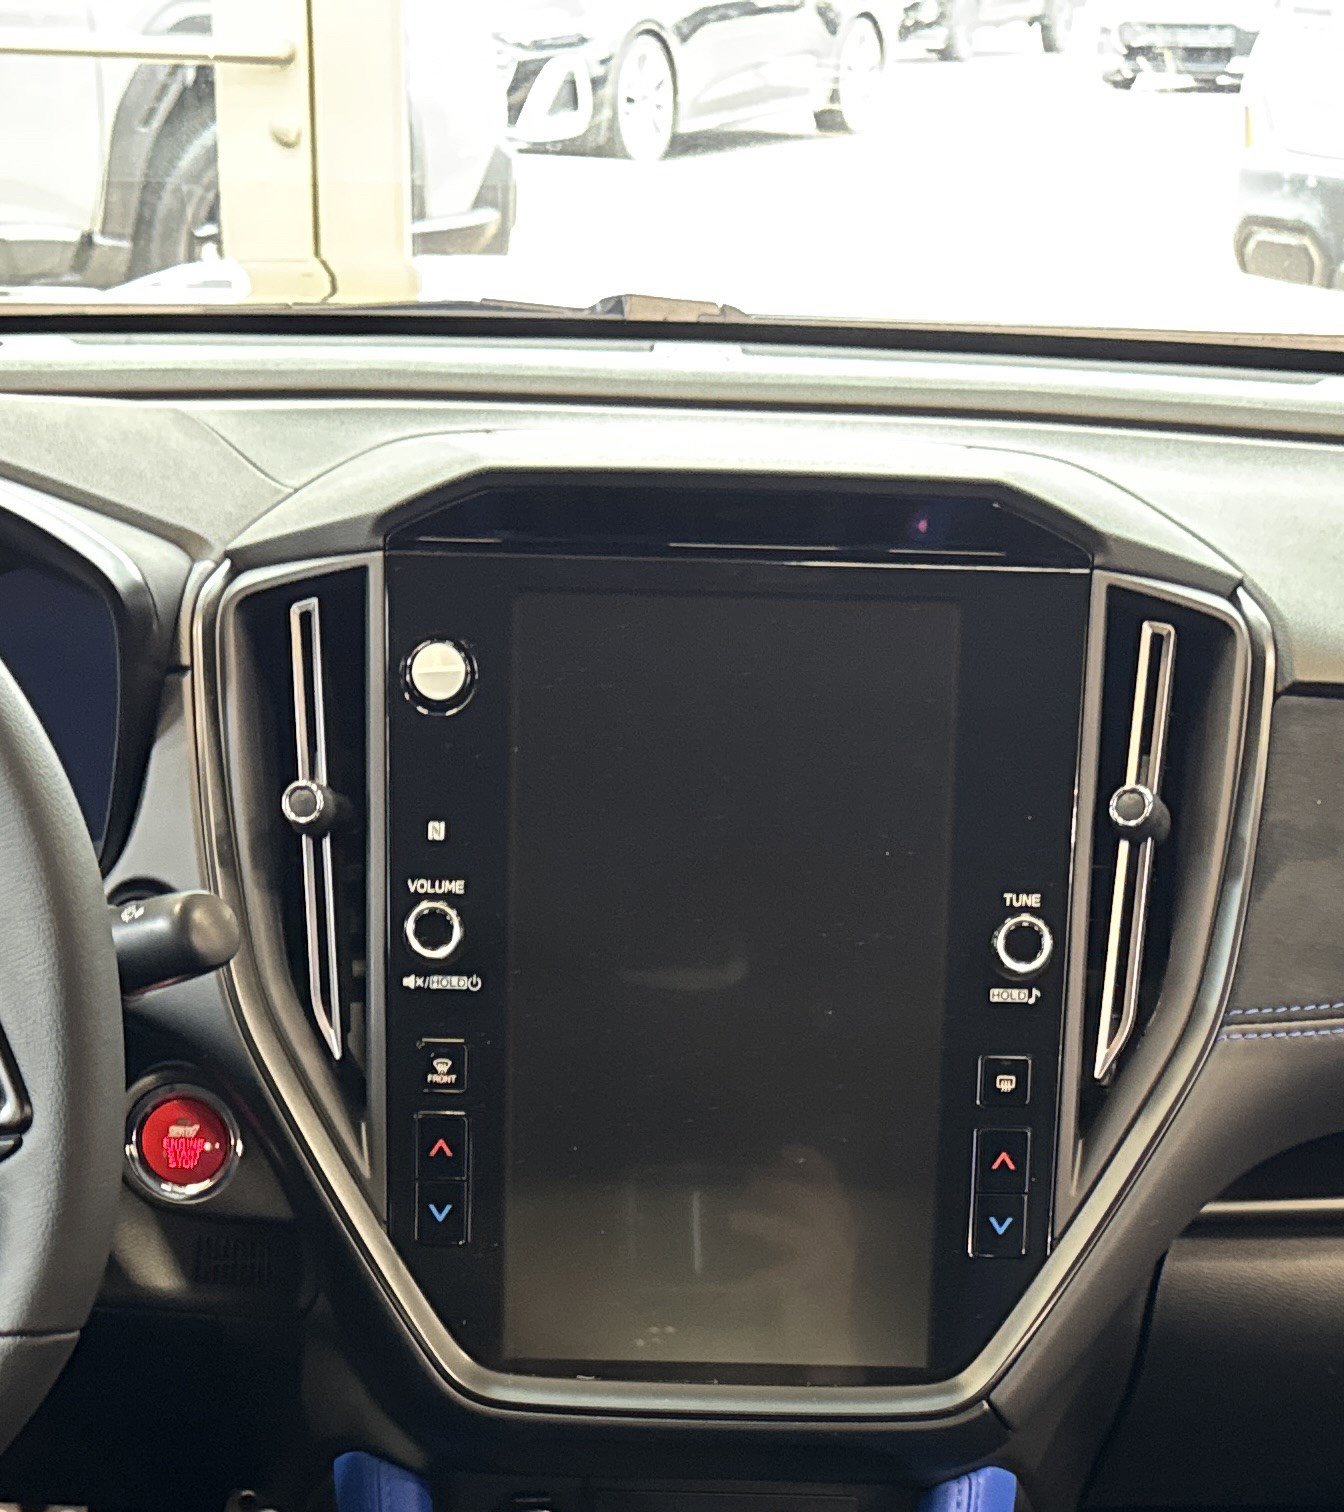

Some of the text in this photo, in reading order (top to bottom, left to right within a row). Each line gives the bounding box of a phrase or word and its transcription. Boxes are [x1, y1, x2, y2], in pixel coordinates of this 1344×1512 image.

[407, 878, 465, 895] VOLUME
[1003, 893, 1041, 908] TUNE
[990, 989, 1028, 1002] HOLD
[427, 1073, 457, 1084] FRONT
